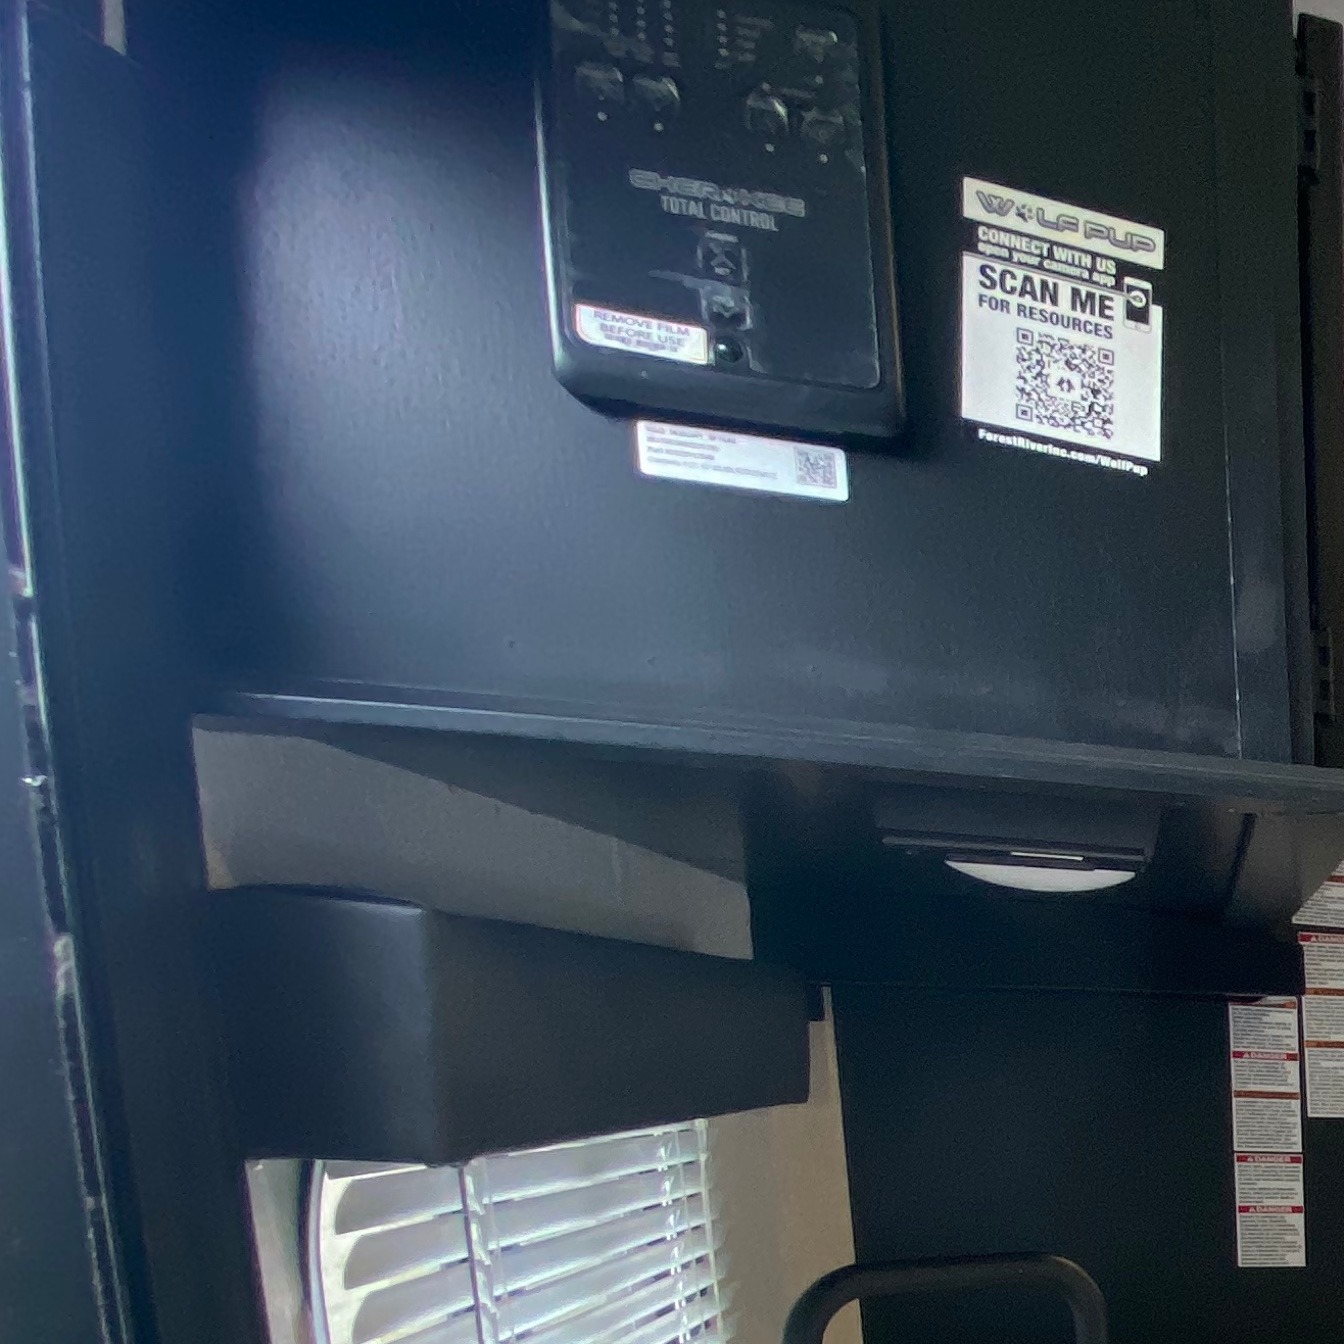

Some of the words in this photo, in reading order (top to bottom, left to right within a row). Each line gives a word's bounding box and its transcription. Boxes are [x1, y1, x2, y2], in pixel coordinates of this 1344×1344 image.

[660, 194, 707, 220] TOTAL
[710, 204, 779, 232] CONTROL
[978, 225, 1050, 257] CONNECT
[1052, 244, 1092, 269] WITH
[1096, 256, 1116, 275] US
[1084, 220, 1156, 253] PUP
[979, 263, 1059, 307] SCAN
[1071, 286, 1114, 322] ME
[594, 310, 652, 330] REMOVE
[657, 322, 690, 336] FILM
[600, 322, 653, 340] BEFORE
[658, 334, 685, 347] USE
[978, 293, 1011, 315] FOR
[1016, 302, 1114, 340] RESOURCES
